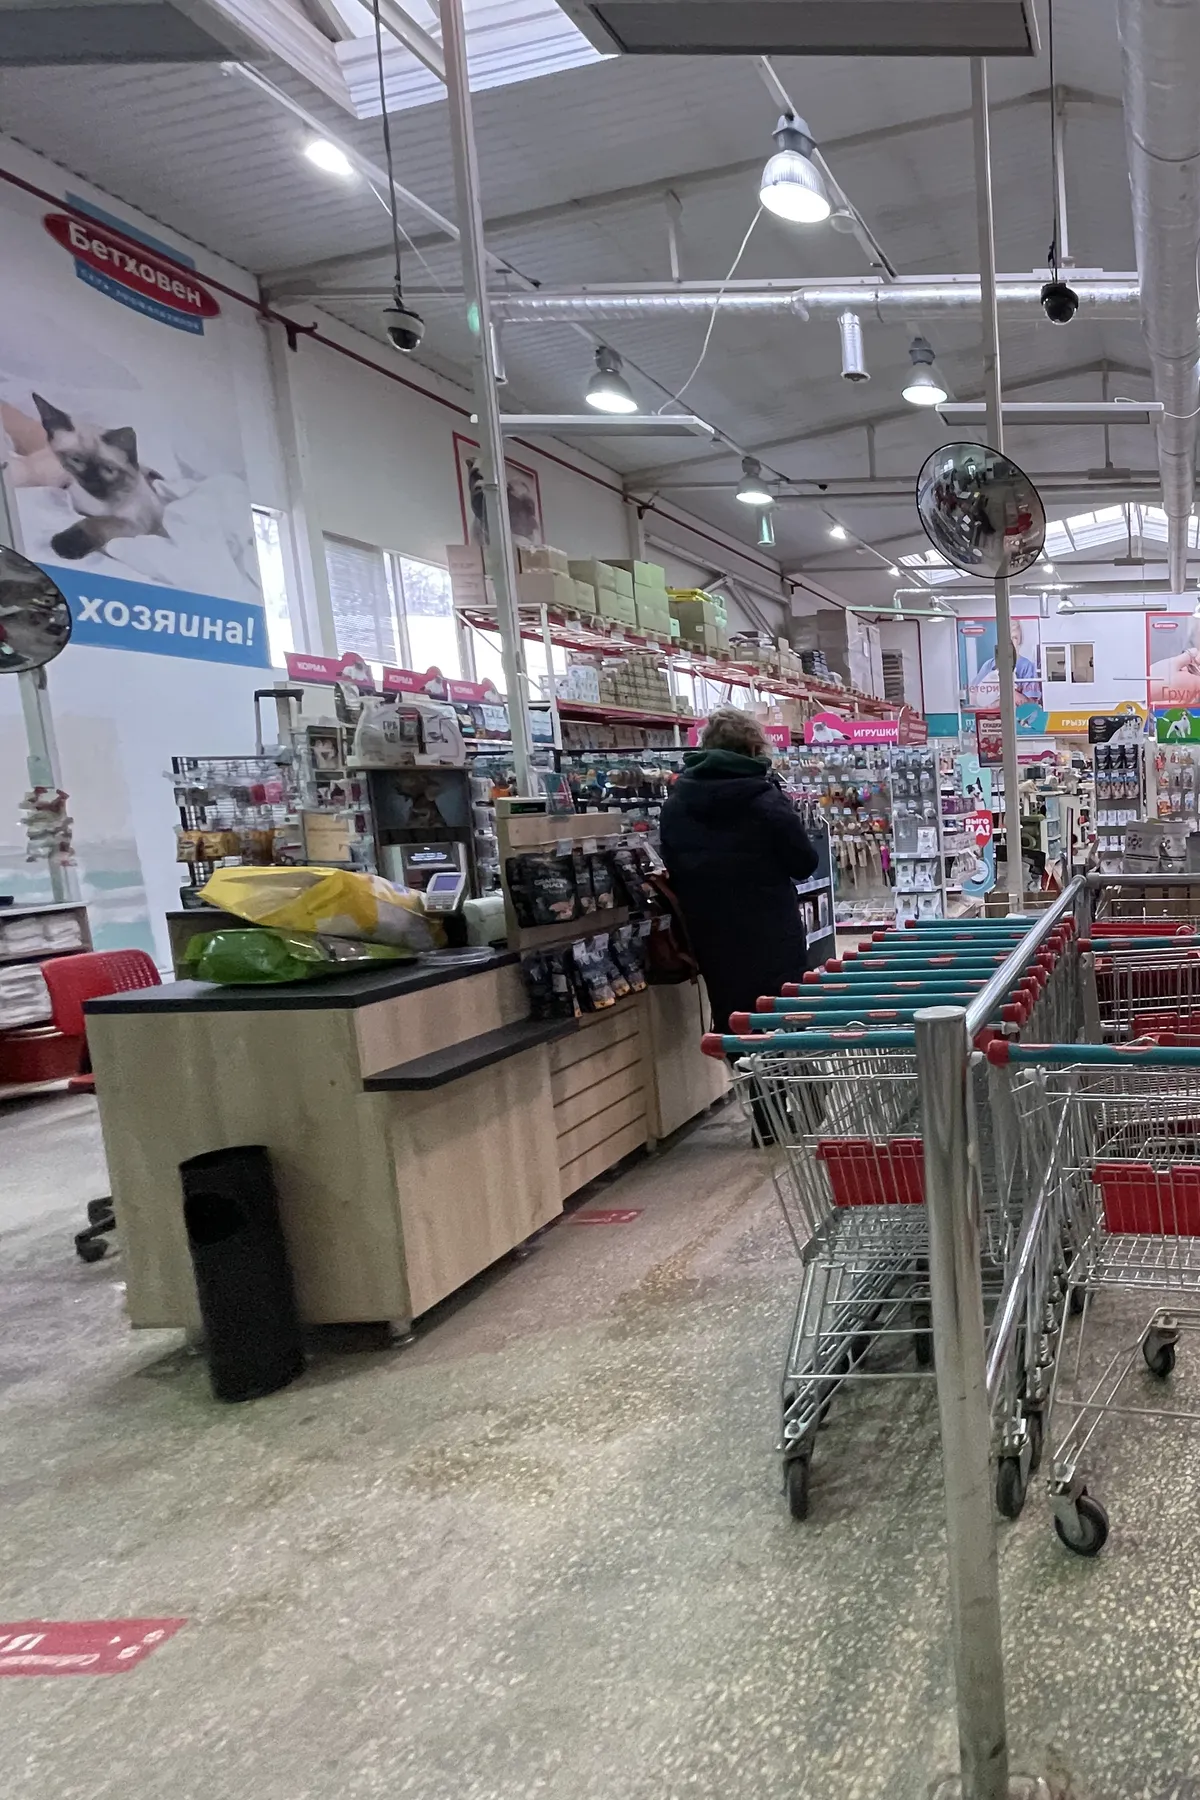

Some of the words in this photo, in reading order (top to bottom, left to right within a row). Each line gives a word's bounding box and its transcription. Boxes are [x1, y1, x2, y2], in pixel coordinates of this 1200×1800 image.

[69, 221, 201, 307] Бетховен
[77, 595, 254, 646] хозяина!
[297, 662, 327, 672] КОРМА
[389, 674, 413, 685] КОРМА
[853, 728, 898, 738] ИГРУШКИ
